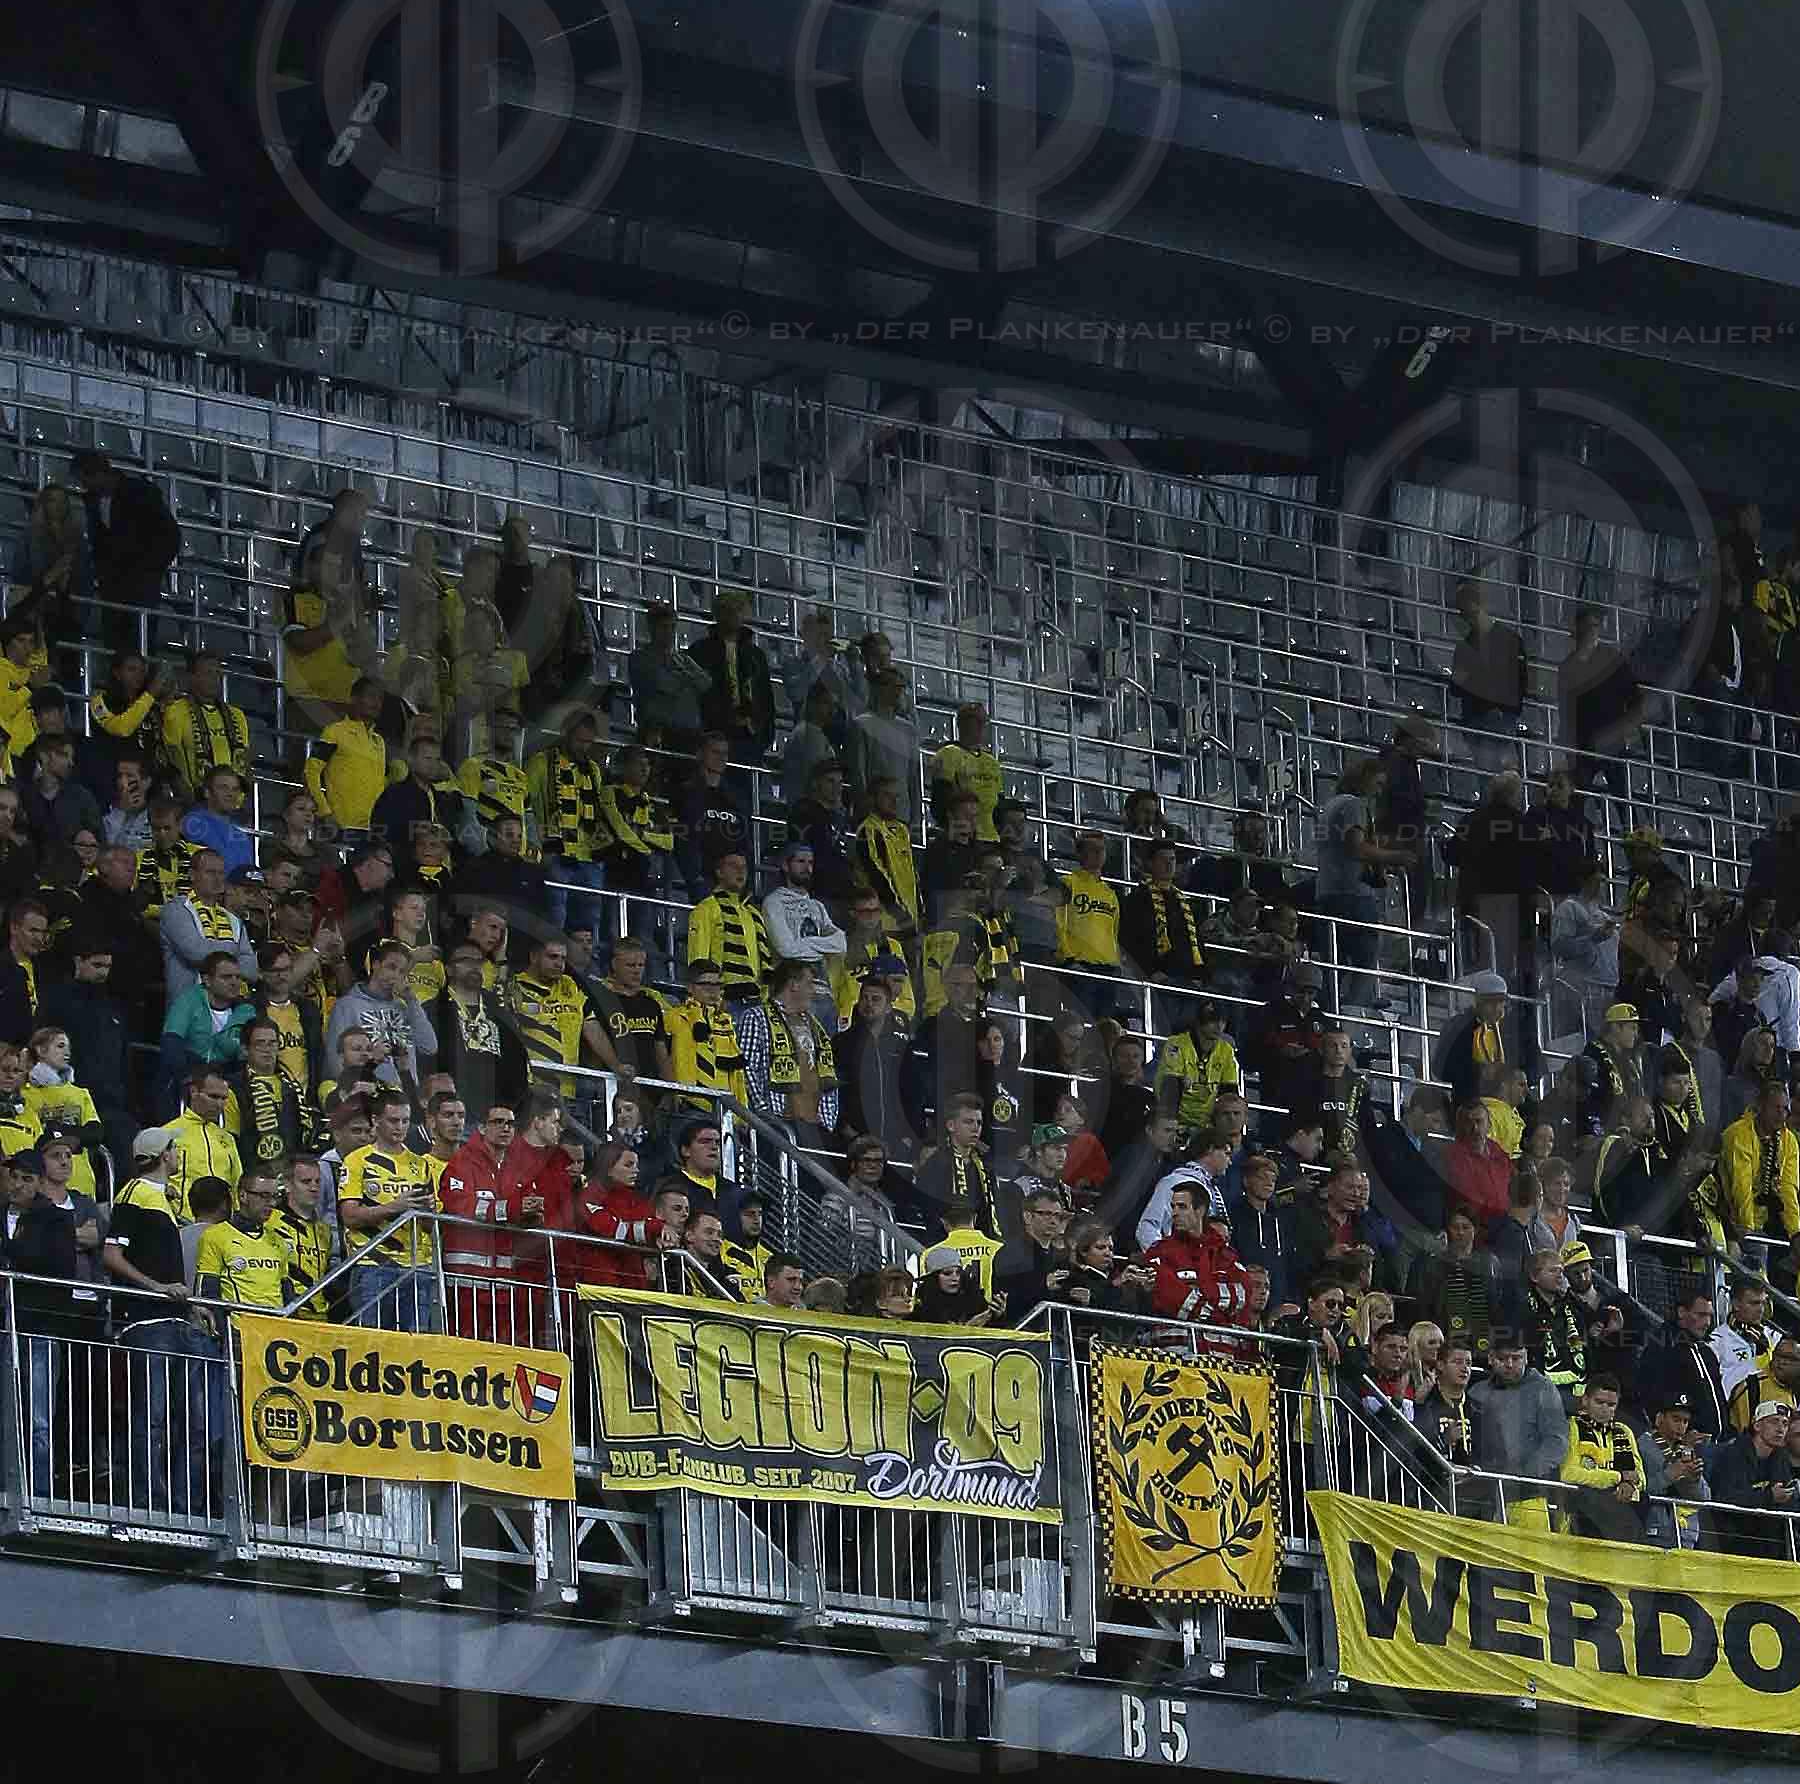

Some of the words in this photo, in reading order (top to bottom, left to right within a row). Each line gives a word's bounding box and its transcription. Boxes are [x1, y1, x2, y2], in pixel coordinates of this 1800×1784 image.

[264, 1339, 512, 1411] Goldstadt
[589, 1311, 914, 1459] LEGION
[938, 1347, 1045, 1474] 09
[264, 1407, 299, 1429] GSB
[313, 1399, 542, 1470] Borussen
[753, 1466, 804, 1489] SEIT
[810, 1469, 857, 1493] 2007
[864, 1436, 1043, 1511] Dortmund
